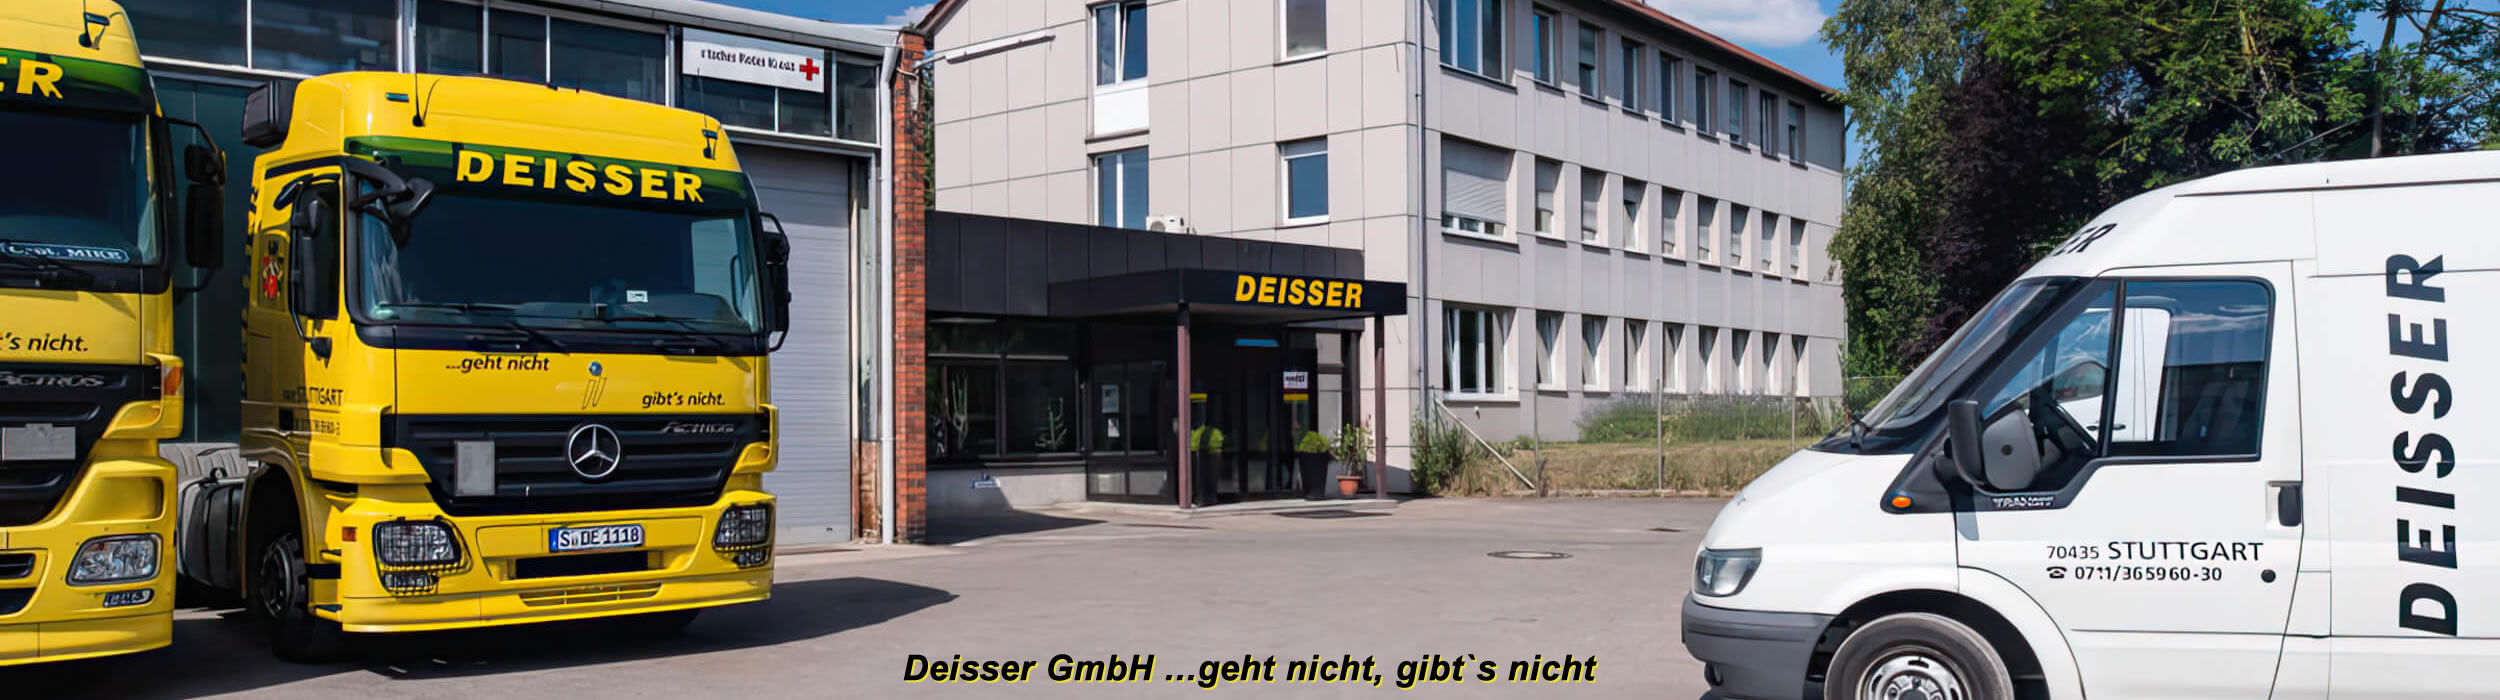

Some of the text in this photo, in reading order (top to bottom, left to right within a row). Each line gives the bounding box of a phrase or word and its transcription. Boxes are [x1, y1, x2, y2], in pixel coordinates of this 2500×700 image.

[456, 150, 703, 203] DEISSER
[1235, 275, 1363, 308] DEISSER
[27, 333, 88, 352] nicht.
[507, 355, 550, 371] nicht
[642, 391, 726, 409] gibt's nicht.
[2386, 254, 2458, 636] DEISSER
[560, 526, 640, 547] S DE 1118
[2047, 541, 2264, 561] 70435 STUTTGART
